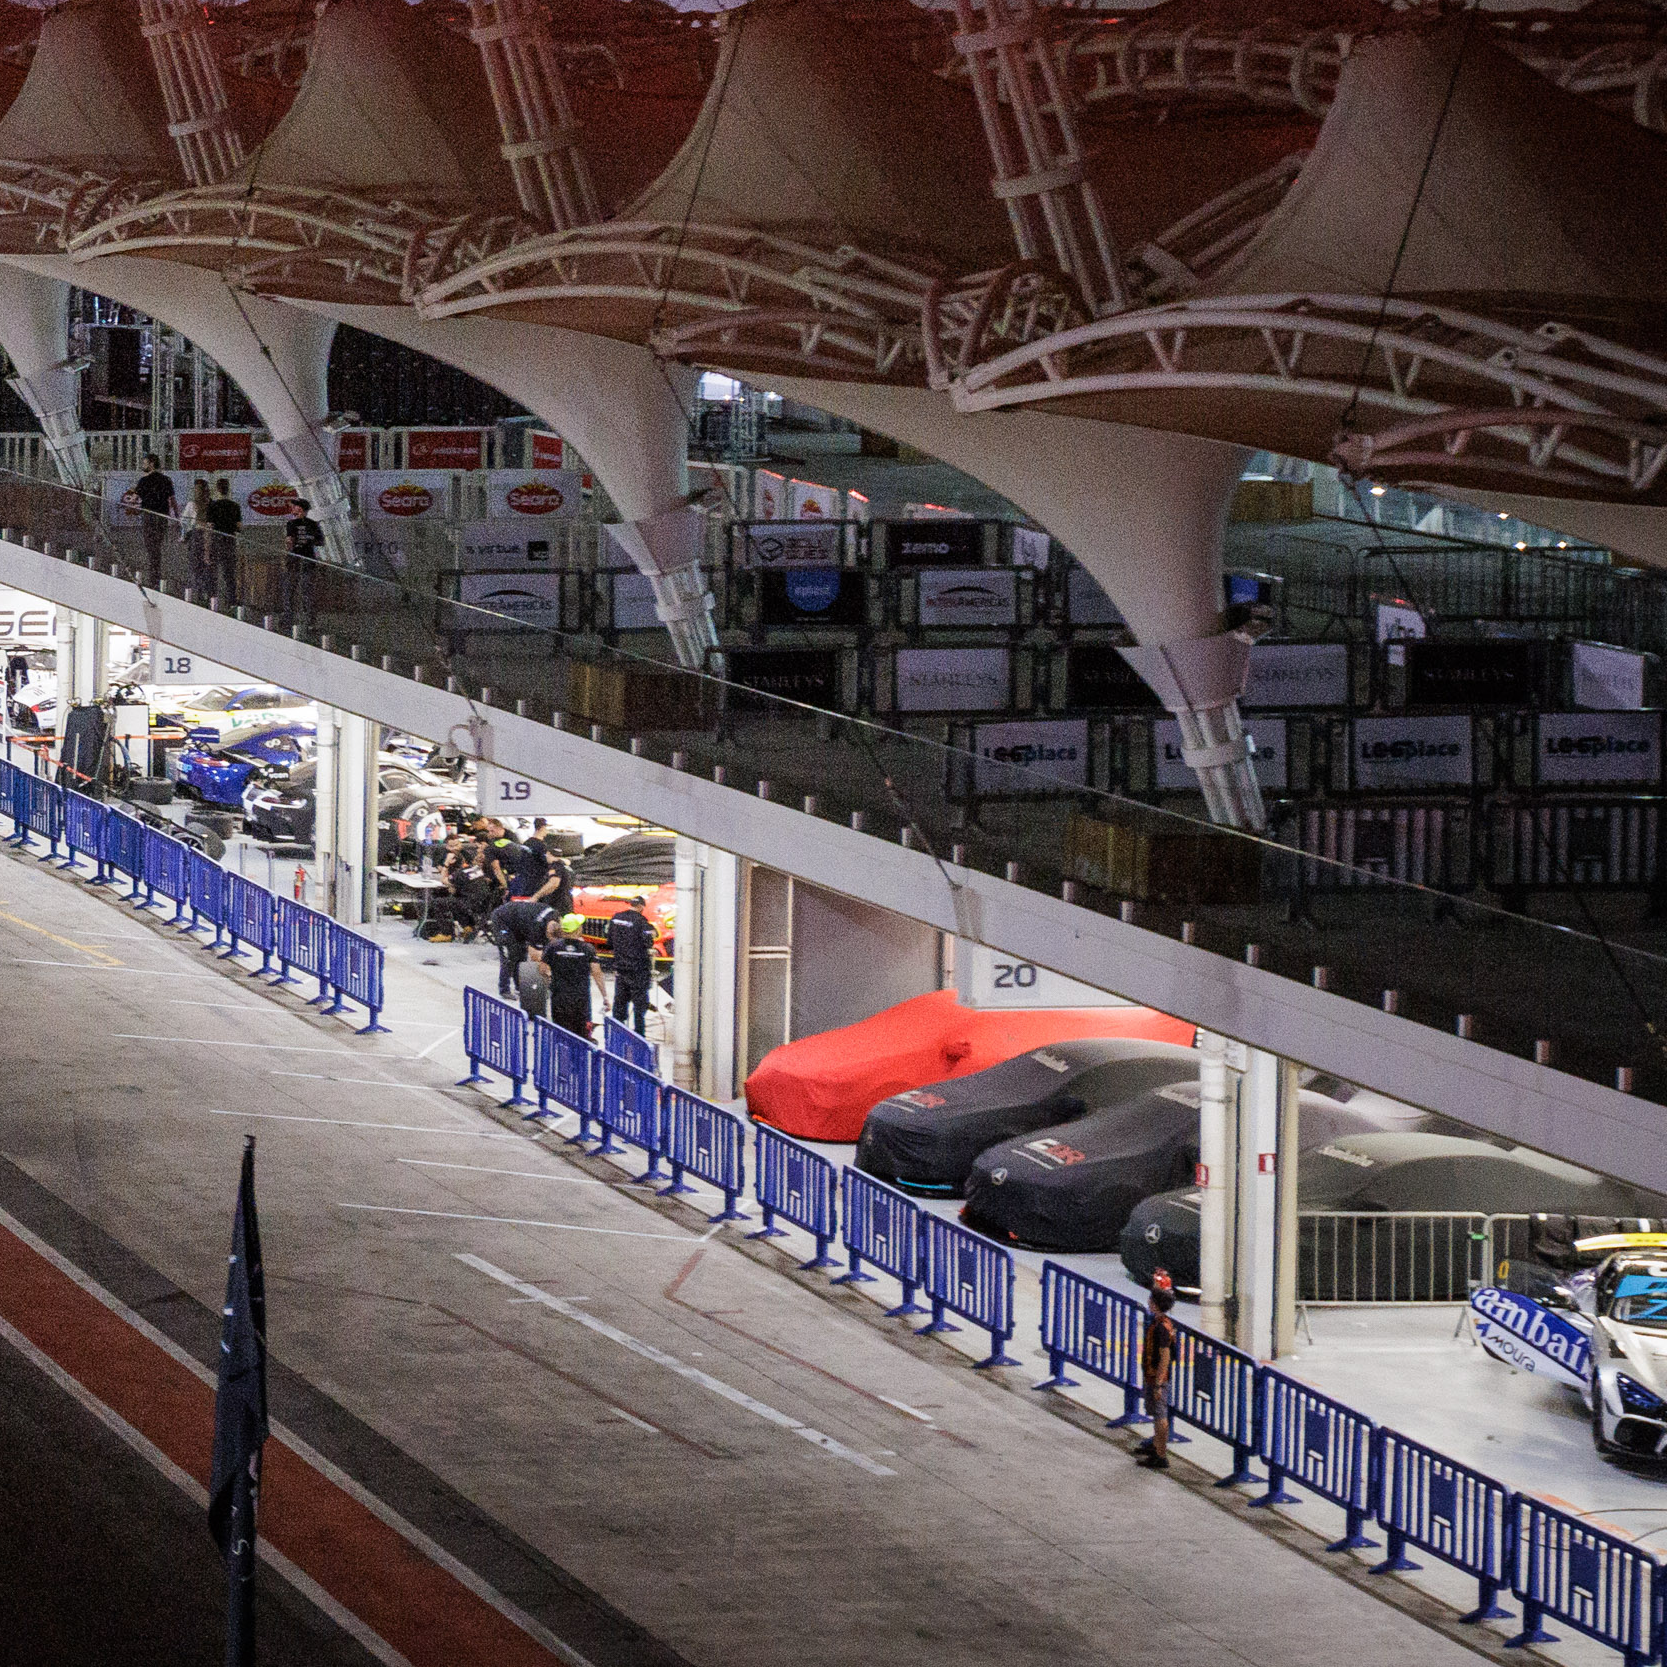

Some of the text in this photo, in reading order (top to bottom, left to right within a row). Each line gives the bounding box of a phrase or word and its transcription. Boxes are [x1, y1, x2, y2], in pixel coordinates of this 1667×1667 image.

[164, 657, 192, 674] 18
[500, 781, 531, 801] 19
[993, 963, 1037, 989] 20
